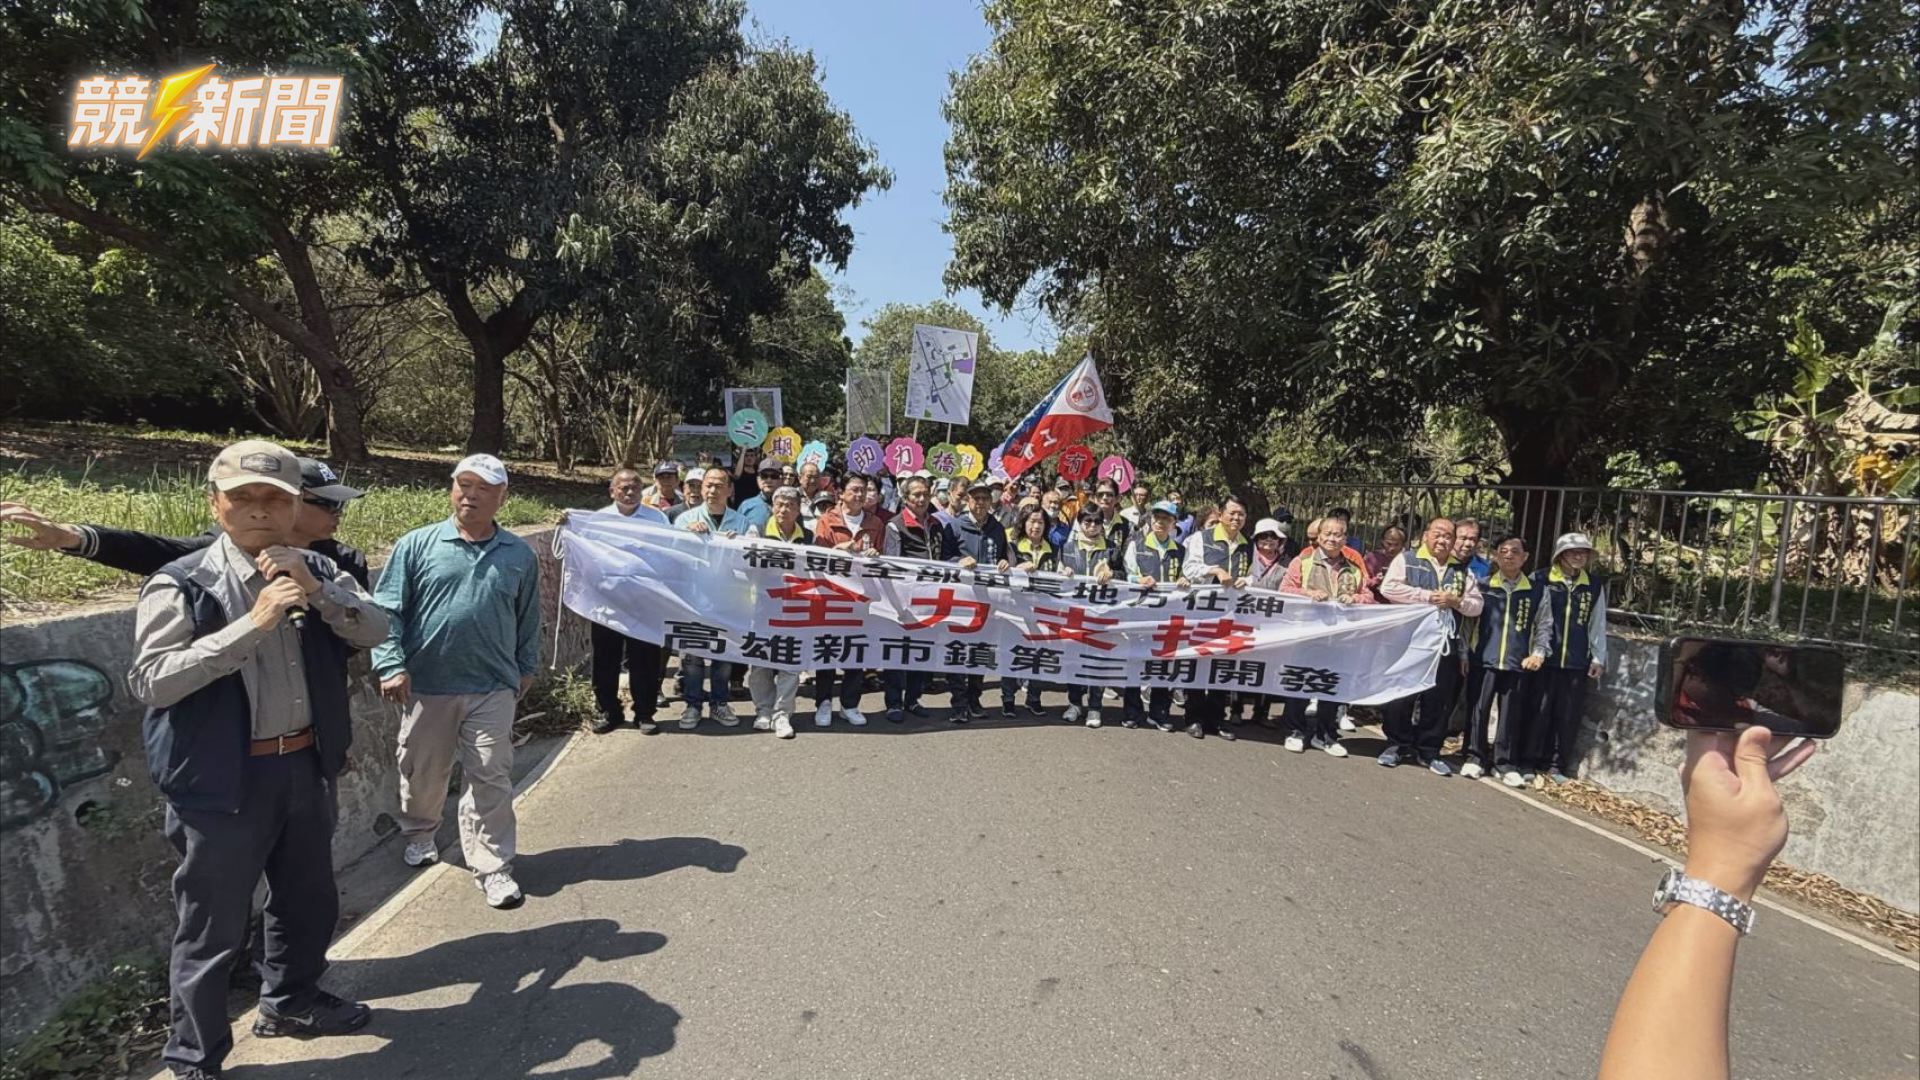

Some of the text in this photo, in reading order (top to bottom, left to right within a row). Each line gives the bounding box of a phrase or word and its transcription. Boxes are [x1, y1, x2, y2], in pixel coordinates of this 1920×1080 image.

[734, 418, 758, 440] 三
[769, 436, 793, 457] 期
[852, 444, 876, 471] 助
[893, 445, 913, 469] 力
[930, 450, 959, 475] 橋
[1065, 452, 1088, 474] 有
[766, 575, 1257, 658] 全力支持
[664, 620, 1340, 696] 高雄新市鎮第三期開發
